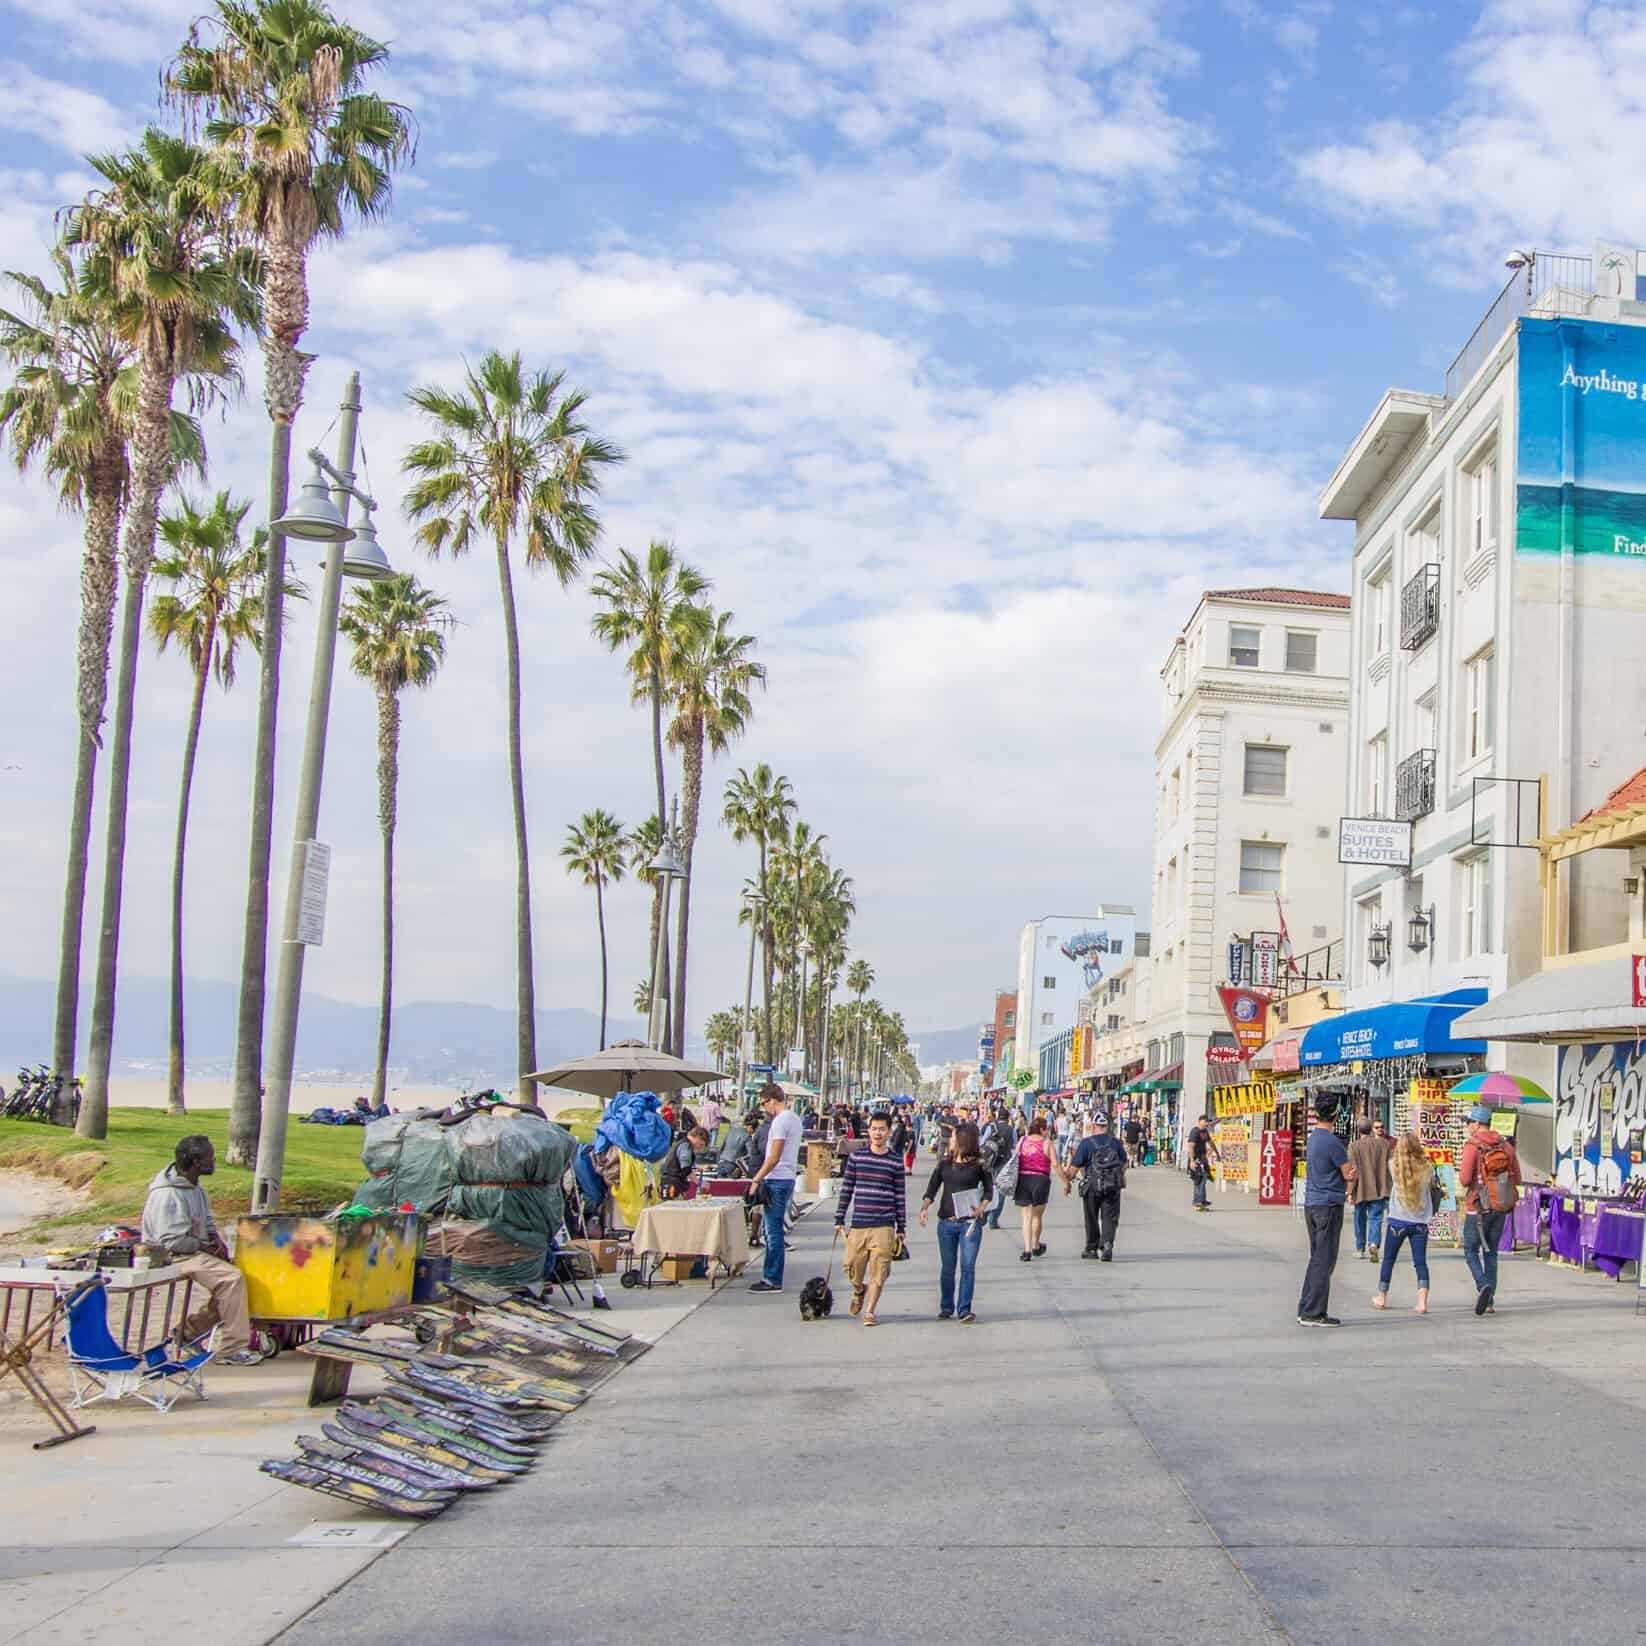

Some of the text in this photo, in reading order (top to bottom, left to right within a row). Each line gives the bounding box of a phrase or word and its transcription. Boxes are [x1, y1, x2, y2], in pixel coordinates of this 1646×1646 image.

[1559, 363, 1637, 399] Anything
[1345, 823, 1408, 833] VENICE BEACH
[1343, 834, 1393, 848] SUITES
[1358, 848, 1408, 861] HOTEL
[1211, 1047, 1240, 1055] GYROS
[1210, 1054, 1241, 1064] FALAFEL
[1417, 1079, 1459, 1090] GLAS
[1215, 1079, 1273, 1110] TATTOO
[1417, 1090, 1449, 1100] PIPE
[1419, 1112, 1451, 1124] BLAC
[1420, 1128, 1451, 1140] MAGI
